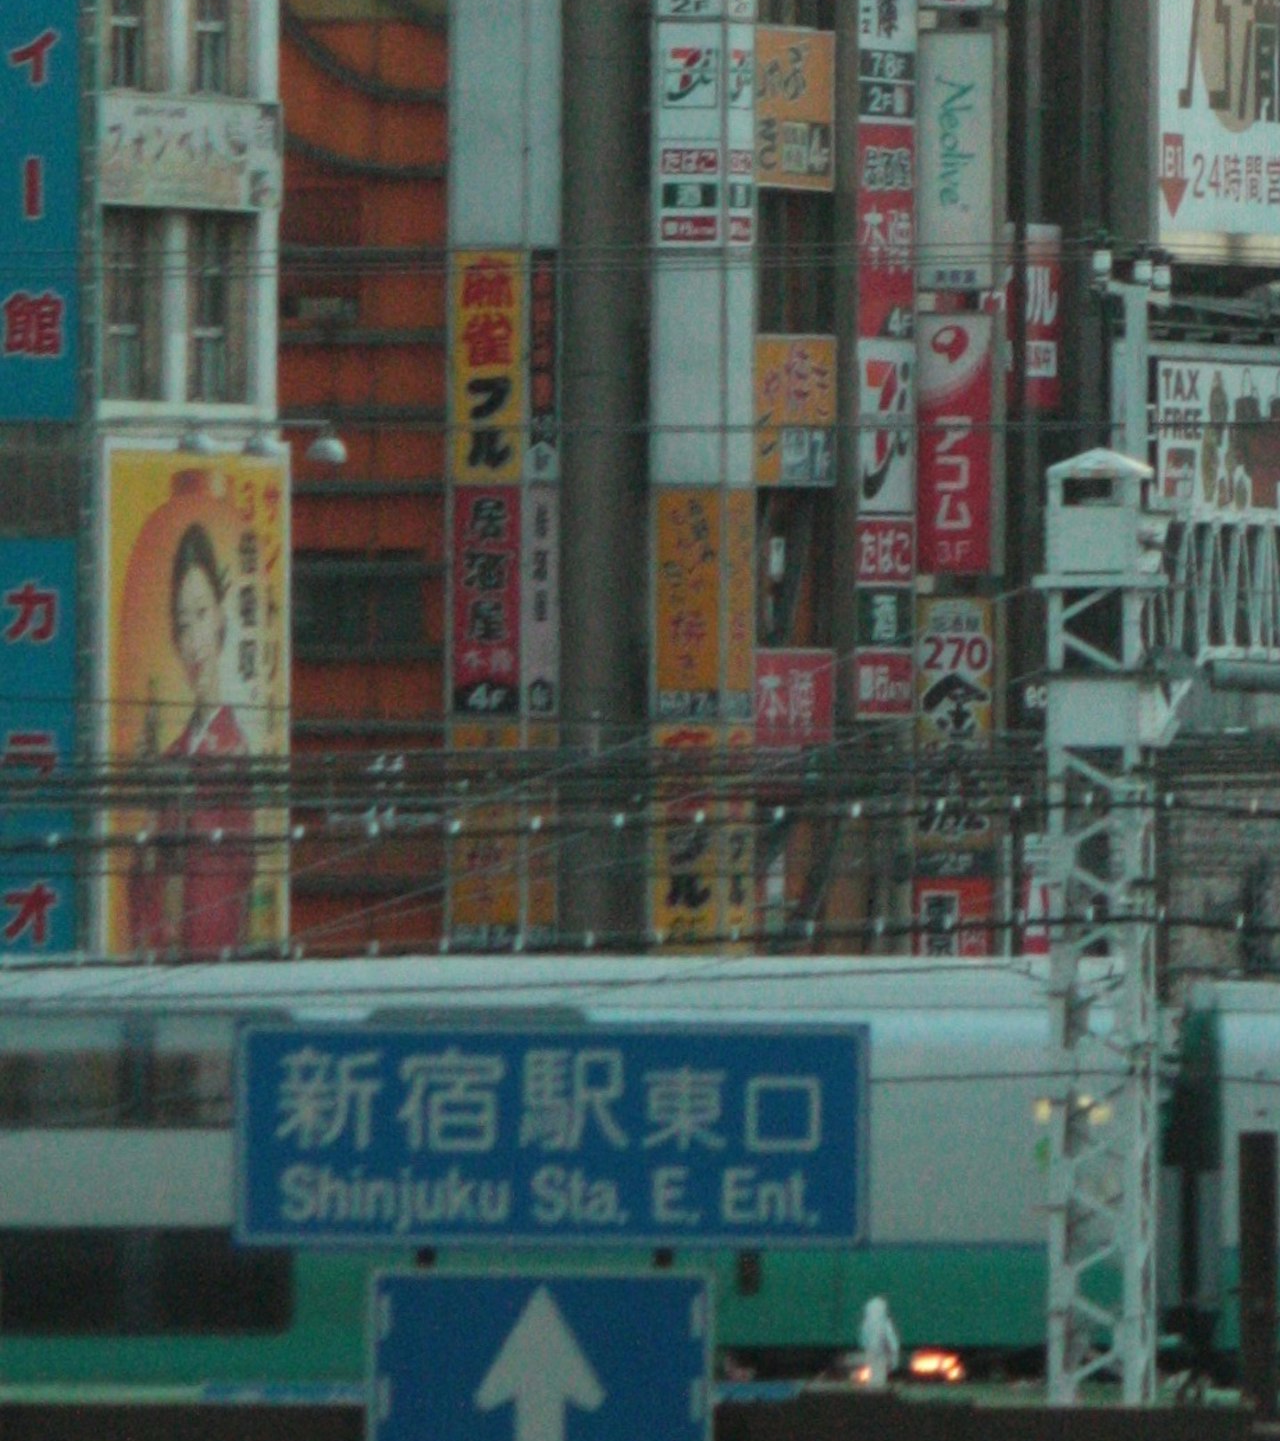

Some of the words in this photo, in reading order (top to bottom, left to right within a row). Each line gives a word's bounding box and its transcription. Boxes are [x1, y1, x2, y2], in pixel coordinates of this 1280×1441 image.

[1161, 369, 1199, 397] TAX
[1160, 408, 1201, 439] FREE
[934, 417, 973, 531] アコム
[923, 635, 990, 672] 270
[274, 1044, 823, 1154] 新宿駅東口
[280, 1165, 511, 1231] Shinjuku
[530, 1165, 628, 1223] Sta.
[652, 1167, 700, 1224] E.
[721, 1167, 820, 1226] Ent.
